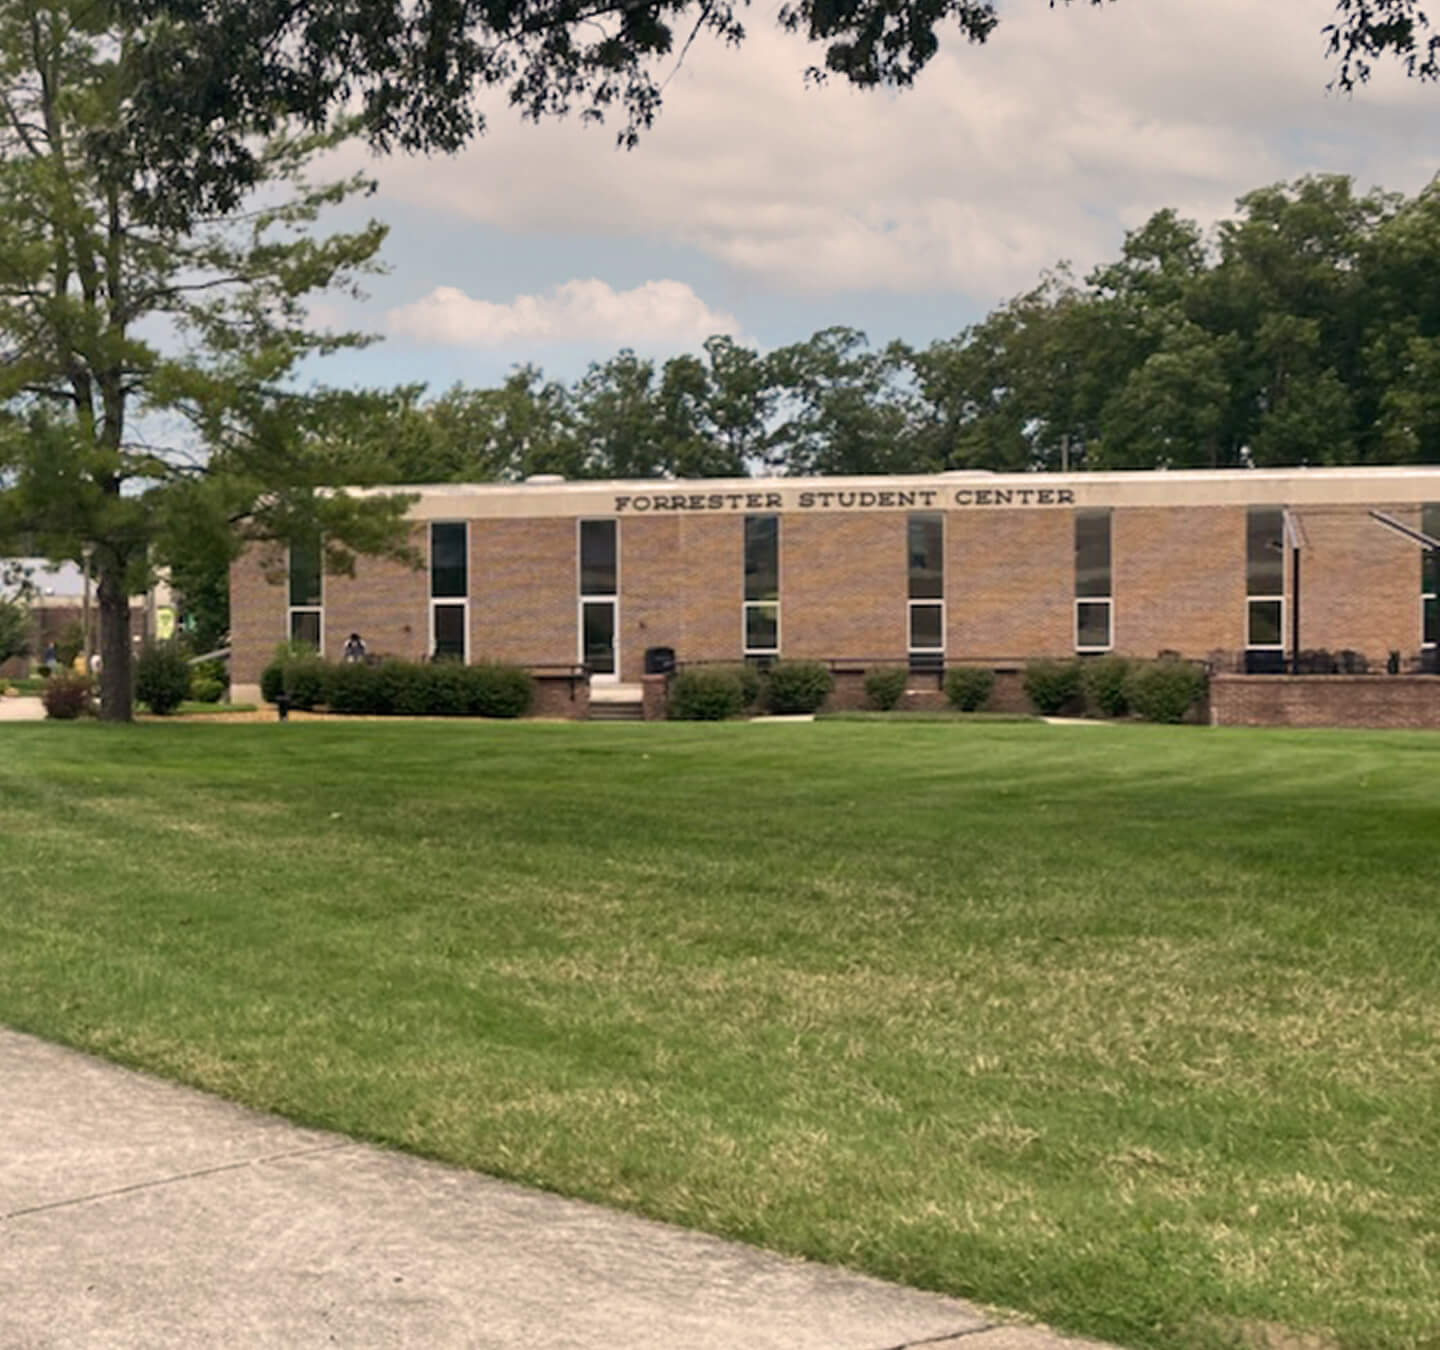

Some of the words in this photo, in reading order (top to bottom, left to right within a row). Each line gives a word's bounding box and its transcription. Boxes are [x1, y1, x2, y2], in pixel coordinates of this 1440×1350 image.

[615, 492, 782, 511] FORRESTER
[798, 491, 937, 508] STUDENT
[955, 489, 1076, 505] CENTER
